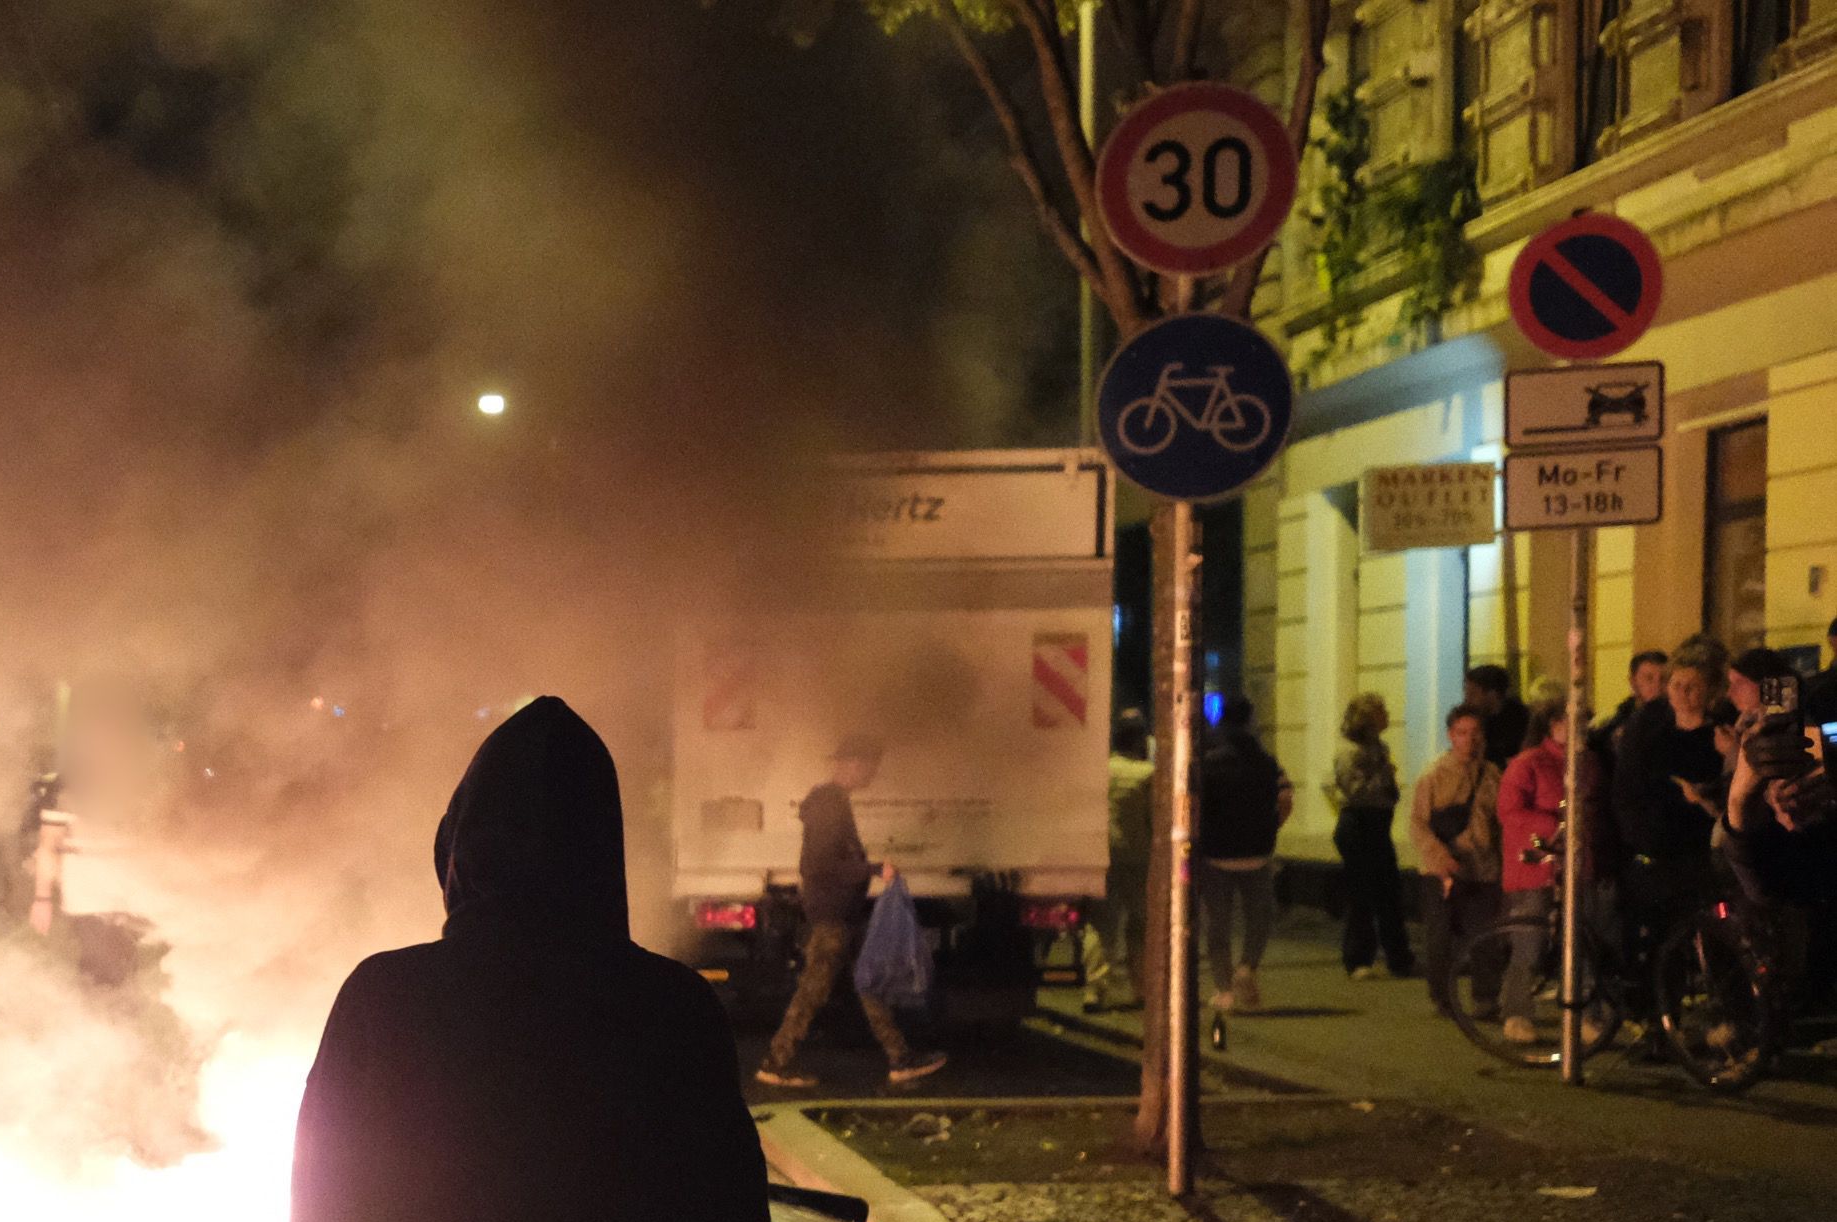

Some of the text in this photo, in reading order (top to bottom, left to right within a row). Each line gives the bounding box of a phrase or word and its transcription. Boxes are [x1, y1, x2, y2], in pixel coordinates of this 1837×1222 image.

[1143, 137, 1252, 223] 30
[1538, 459, 1626, 486] Mo-Fr
[1544, 492, 1624, 515] 13-18h
